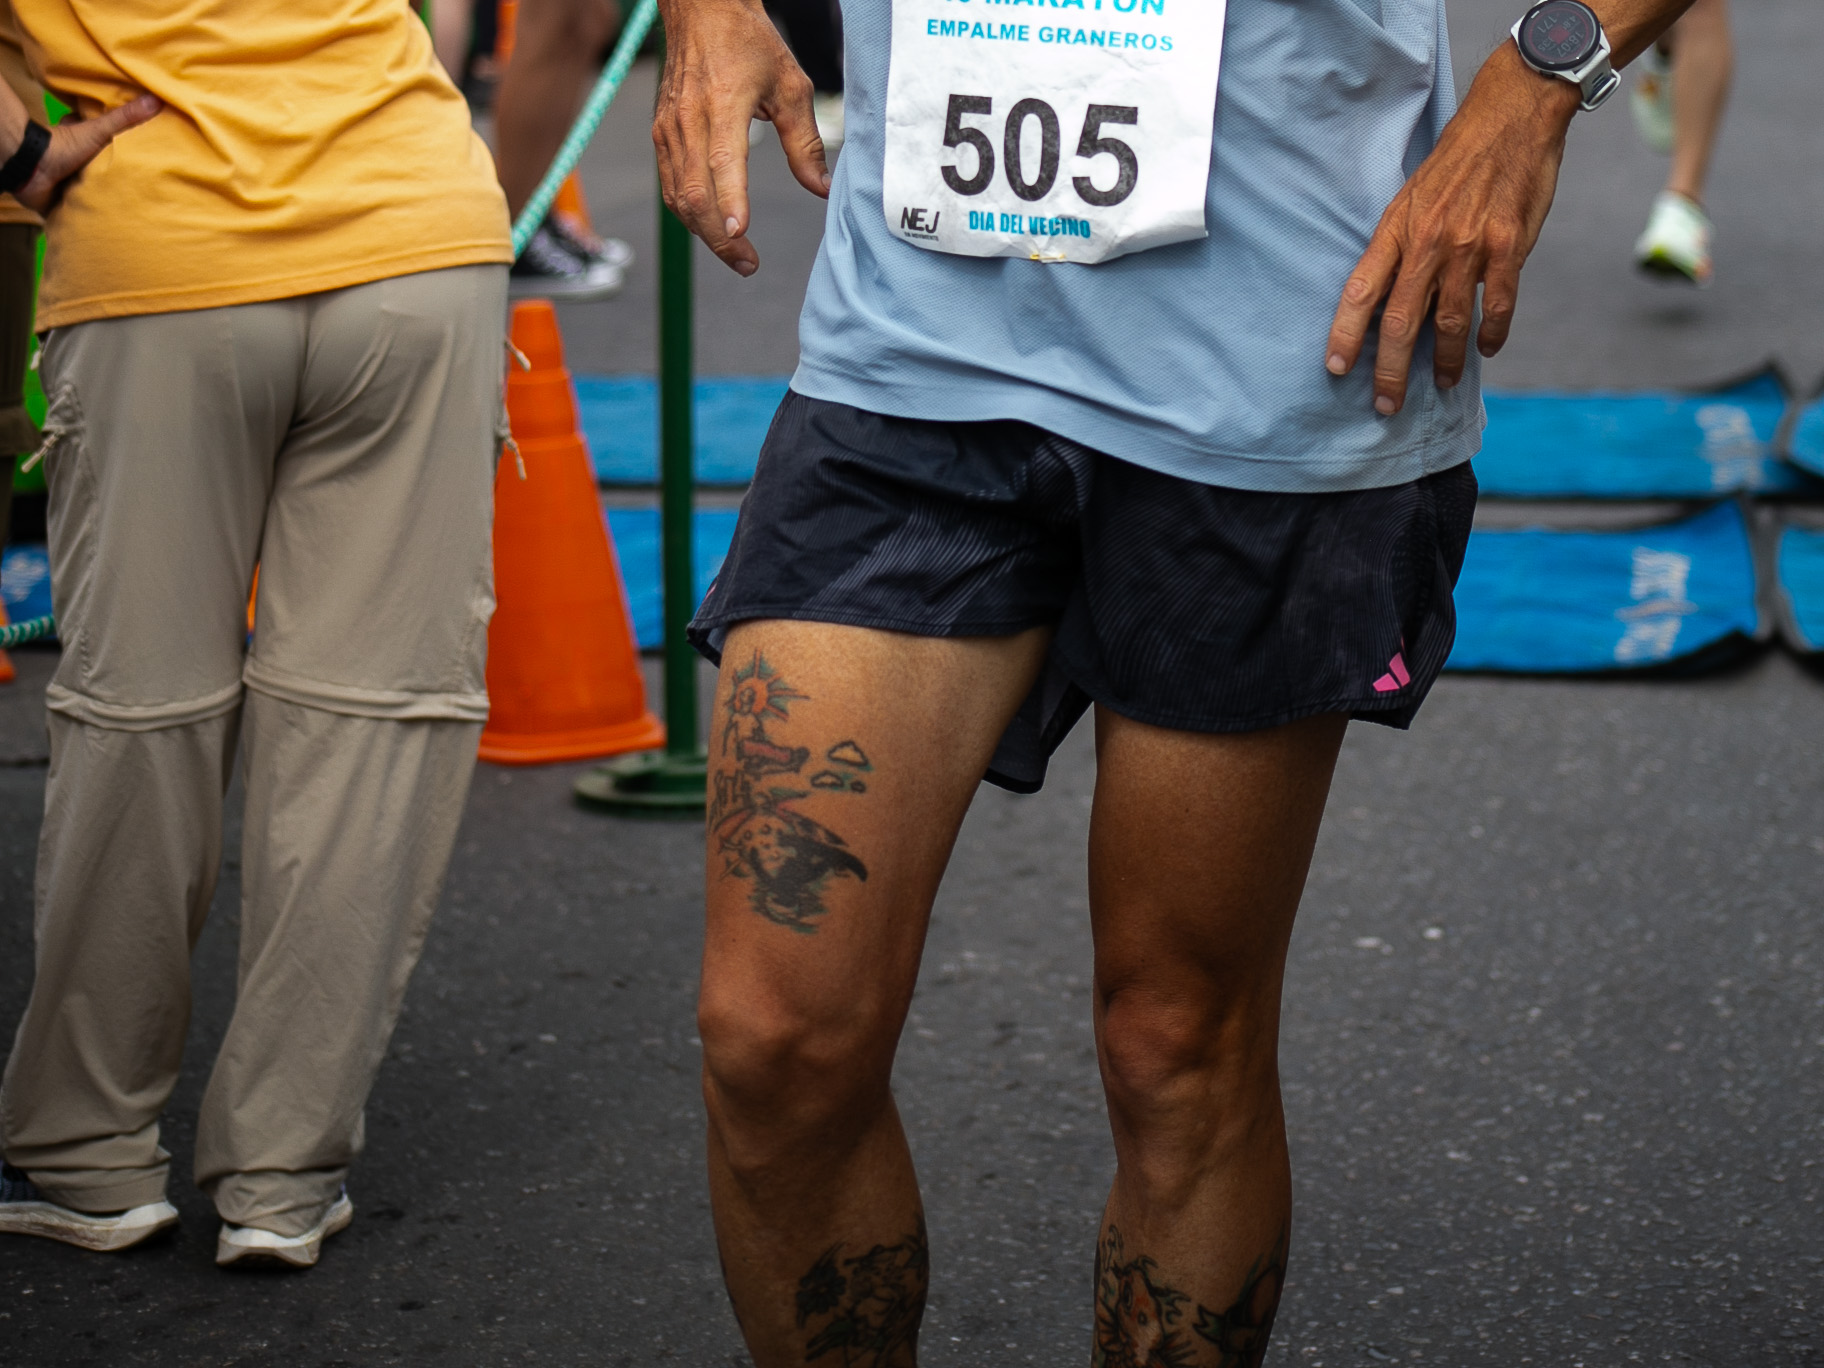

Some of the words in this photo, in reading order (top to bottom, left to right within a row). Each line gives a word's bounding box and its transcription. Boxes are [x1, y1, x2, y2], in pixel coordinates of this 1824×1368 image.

[927, 19, 1030, 42] EMPALME
[1038, 26, 1173, 51] GRANEROS
[940, 94, 1139, 207] 505
[900, 207, 940, 234] NEJ
[969, 210, 996, 232] DIA
[1000, 213, 1025, 234] DEL
[1029, 215, 1091, 239] VECINO
